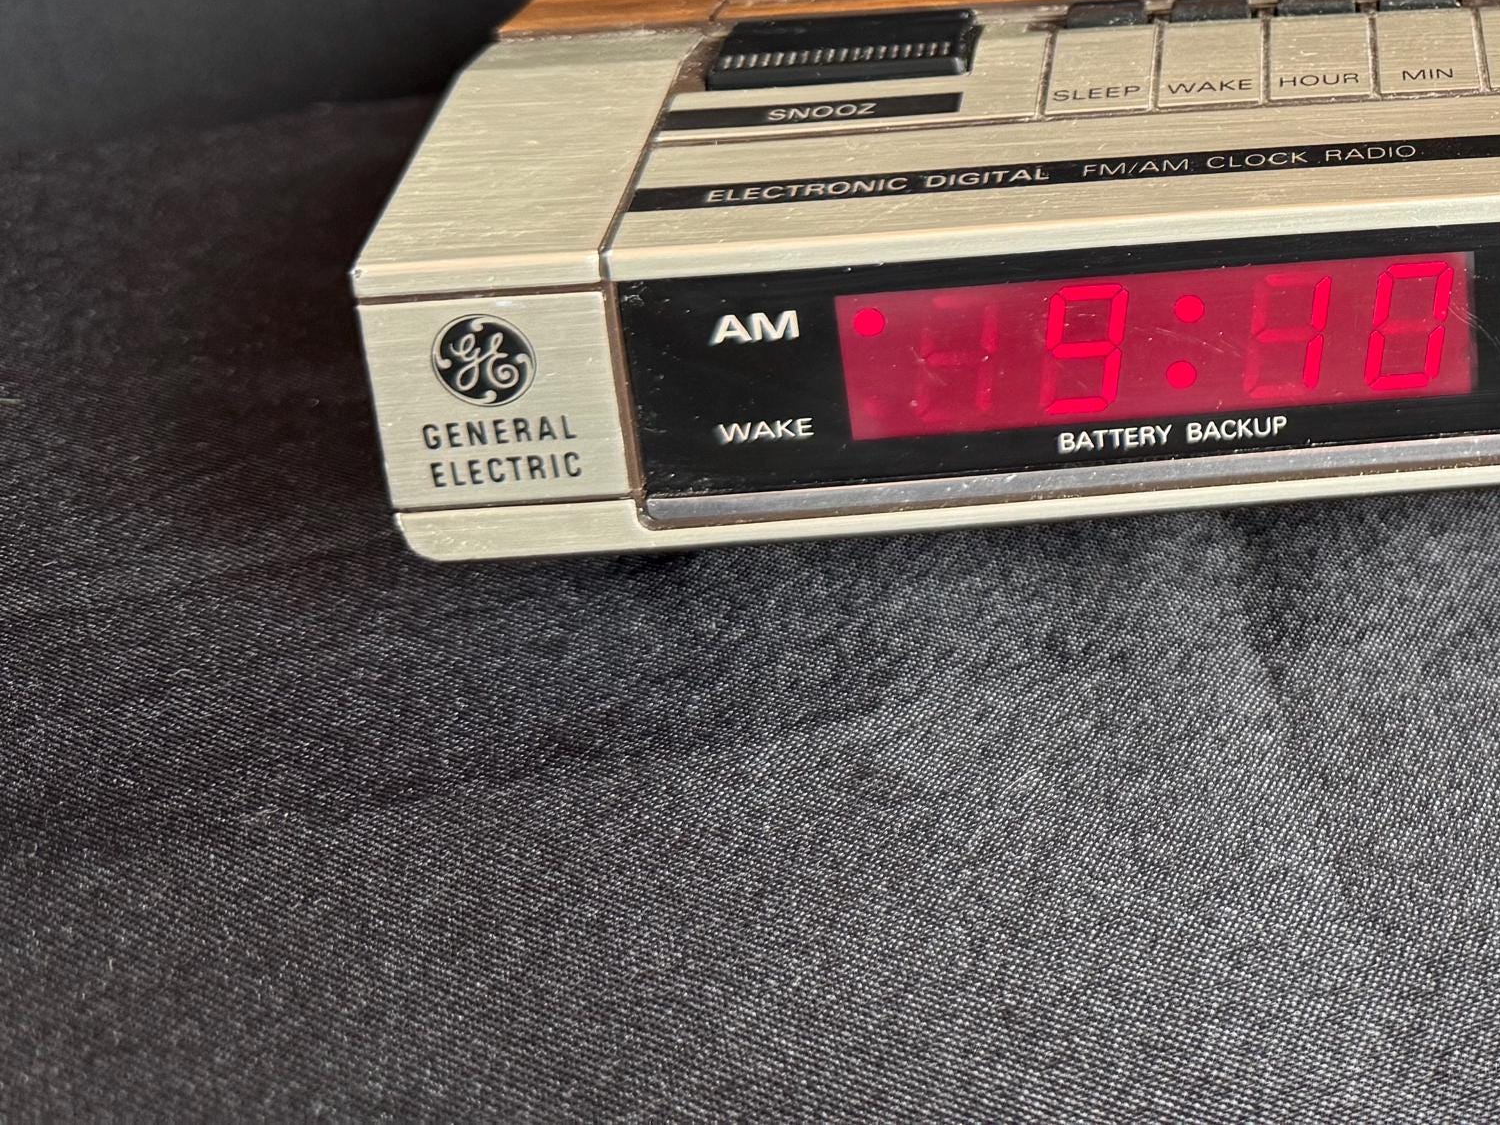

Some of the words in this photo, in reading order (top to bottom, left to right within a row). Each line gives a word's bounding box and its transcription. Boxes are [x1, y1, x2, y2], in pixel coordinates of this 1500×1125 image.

[1167, 77, 1255, 95] WAKE
[1279, 72, 1360, 88] HOUR
[1402, 67, 1455, 82] MIN
[1052, 84, 1142, 103] SLEEP
[767, 101, 878, 122] SNOOZ
[705, 176, 908, 205] ELECTRONIC
[924, 165, 1051, 190] DIGITAL
[1083, 156, 1190, 178] FM/AM
[1206, 149, 1309, 170] CLOCK
[1324, 143, 1417, 162] RADIO
[708, 308, 801, 347] AM
[1044, 261, 1453, 414] 9:10
[422, 415, 577, 450] GENERAL
[716, 416, 815, 445] WAKE
[1057, 424, 1172, 455] BATTERY
[1186, 415, 1288, 442] BACKUP
[430, 451, 584, 488] ELECTRIC
